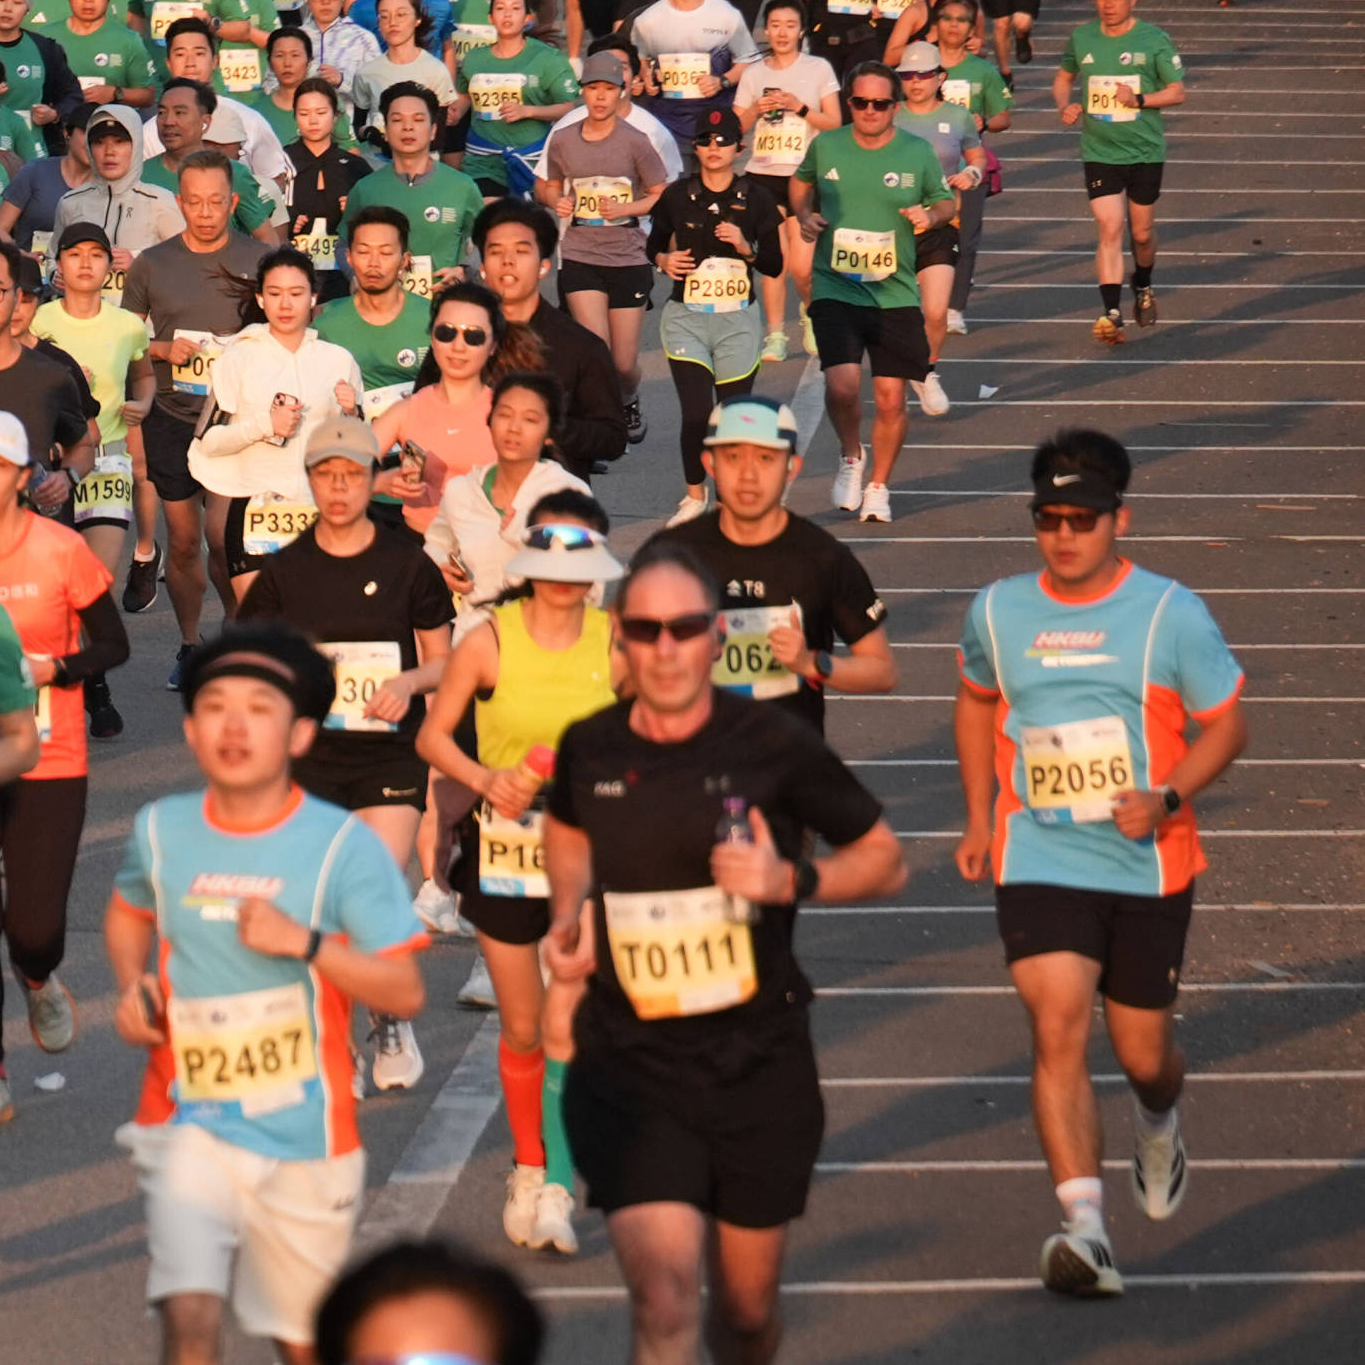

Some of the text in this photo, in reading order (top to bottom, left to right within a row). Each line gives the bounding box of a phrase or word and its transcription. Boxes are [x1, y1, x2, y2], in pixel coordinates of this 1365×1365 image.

[473, 90, 521, 107] P2365
[1092, 94, 1127, 107] P01
[757, 138, 802, 151] M3142
[836, 250, 893, 267] P0146
[689, 279, 748, 296] P2860
[74, 479, 132, 503] M1599
[744, 580, 765, 597] T8
[712, 641, 781, 674] 062
[1030, 756, 1128, 796] P2056
[489, 842, 544, 868] P16
[620, 935, 739, 979] T0111
[183, 1031, 303, 1084] P2487
